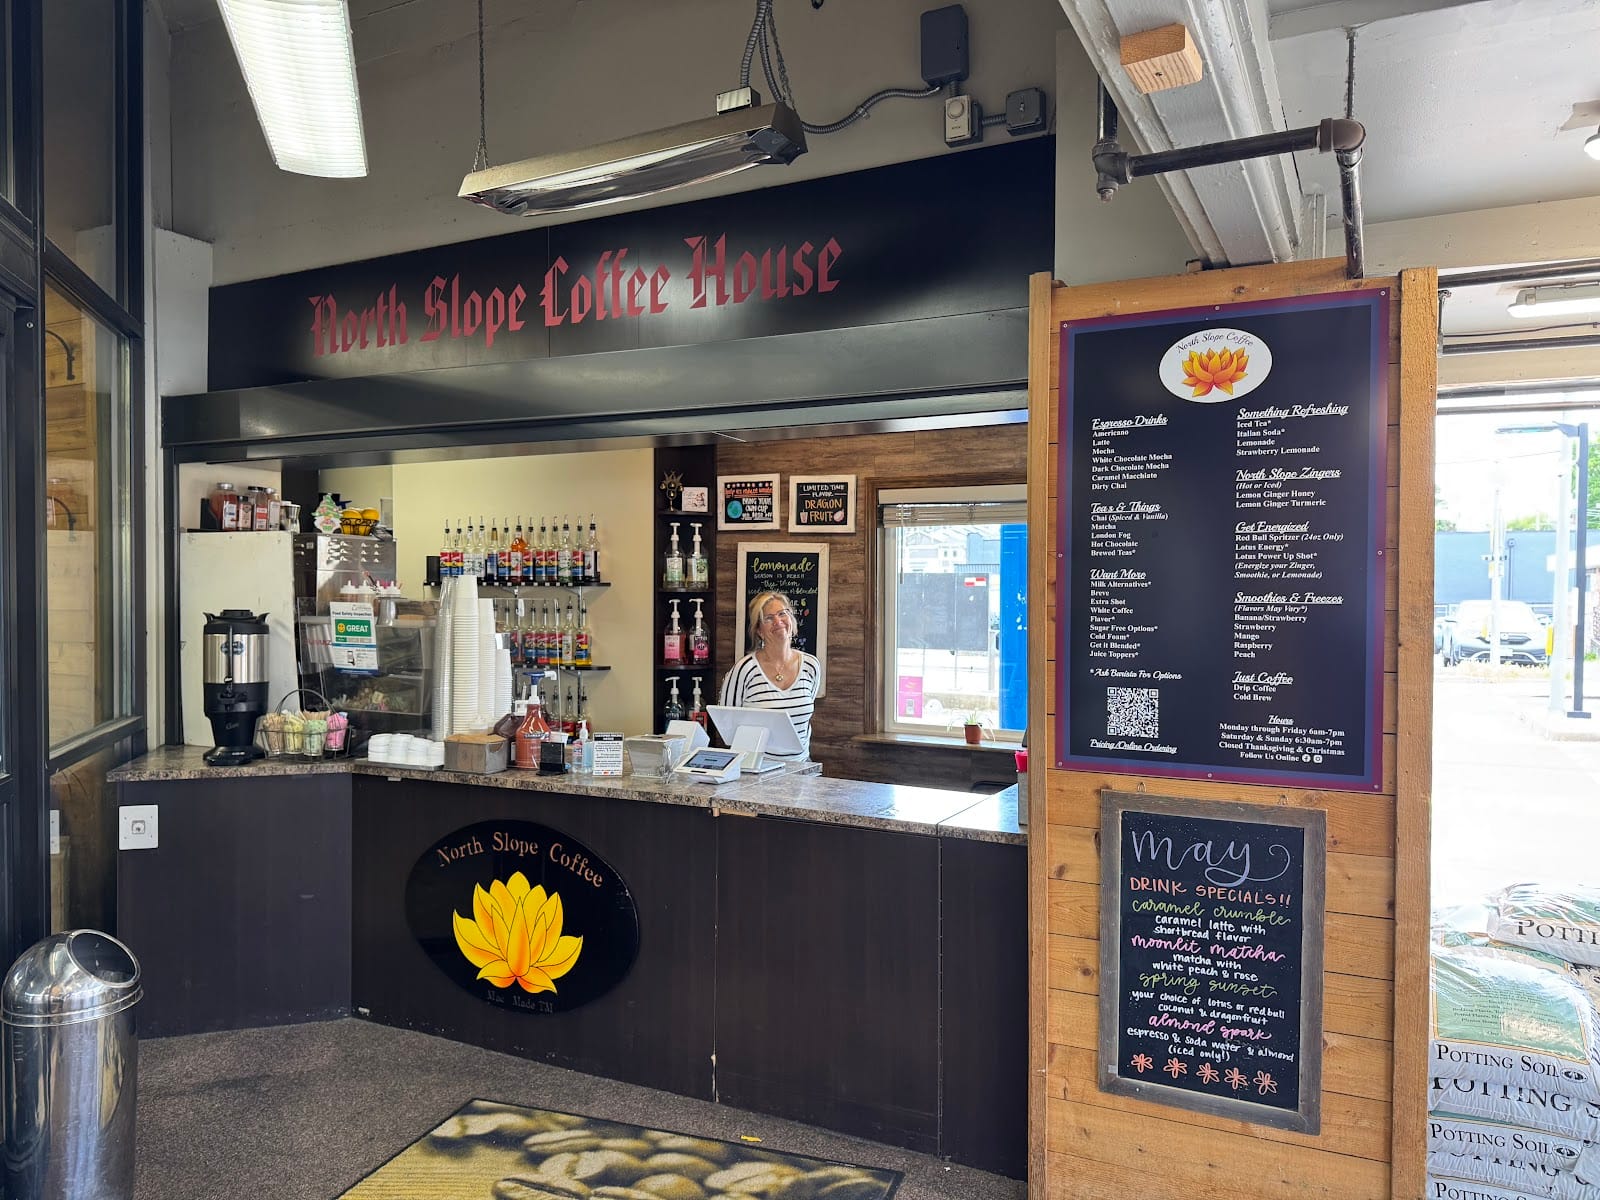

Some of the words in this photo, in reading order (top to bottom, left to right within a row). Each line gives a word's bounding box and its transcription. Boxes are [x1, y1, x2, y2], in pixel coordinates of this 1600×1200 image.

[308, 283, 408, 359] North
[419, 271, 528, 348] Slope
[539, 247, 671, 327] Coffee
[683, 232, 843, 309] House
[1175, 335, 1199, 354] North
[1201, 332, 1224, 343] Slope
[1226, 332, 1254, 347] Coffee
[1237, 407, 1290, 420] Something
[1291, 404, 1349, 417] Refreshing
[1092, 418, 1135, 430] Espresso
[1134, 414, 1168, 427] Drinks
[1092, 429, 1129, 437] Americano
[1236, 469, 1268, 481] North
[1270, 468, 1299, 481] Slope
[1301, 467, 1341, 480] Zingers
[1263, 491, 1289, 499] Ginger
[1292, 490, 1315, 498] Honey
[804, 498, 843, 509] DRAGON
[809, 511, 833, 522] FRUIT
[1235, 522, 1255, 533] Get
[1256, 521, 1309, 533] Energized
[1269, 533, 1300, 542] Spritzer
[1323, 533, 1343, 541] Only)
[751, 557, 815, 573] lemonade
[1090, 569, 1122, 579] Want
[1123, 569, 1146, 579] More
[1234, 592, 1288, 603] Smoothies
[1290, 593, 1303, 604] &
[1304, 593, 1344, 604] Freezes
[1235, 614, 1307, 622] Banana/Strawberry
[1234, 623, 1276, 631] Strawberry
[1234, 642, 1272, 650] Raspberry
[1232, 671, 1256, 685] Just
[1258, 672, 1293, 686] Coffee
[1234, 684, 1250, 692] Drip
[1220, 723, 1249, 732] Monday
[1251, 725, 1280, 734] through
[1283, 727, 1307, 735] Friday
[1309, 728, 1344, 737] 6am-7pm
[1221, 733, 1254, 742] Saturday
[1265, 735, 1293, 744] Sunday
[1295, 736, 1342, 747] 6:30am-7pm
[1245, 743, 1297, 754] Thanksgiving
[1306, 746, 1344, 756] Christmas
[436, 836, 485, 867] North
[492, 831, 539, 857] Slope
[549, 842, 603, 887] Coffee
[1129, 877, 1187, 896] DRINK
[1195, 885, 1291, 909] SPECIALS!!
[1132, 899, 1206, 916] caramel
[1213, 905, 1291, 926] crumble
[1155, 915, 1202, 928] caramel
[1209, 919, 1235, 932] latte
[1241, 924, 1266, 936] with
[1153, 925, 1210, 940] shortbread
[1215, 932, 1252, 943] flavor
[1131, 934, 1201, 954] moonlit
[1210, 944, 1286, 962] matcha
[1173, 954, 1211, 966] matcha
[1216, 959, 1241, 970] with
[1152, 961, 1184, 971] white
[1188, 965, 1218, 976] peach
[1234, 971, 1258, 982] rose
[1139, 972, 1201, 995] spring
[1208, 978, 1278, 997] sunset
[1131, 990, 1155, 1001] your
[1160, 992, 1187, 1004] choice
[1208, 998, 1233, 1009] lotus
[1236, 1003, 1244, 1011] or
[1158, 1003, 1194, 1015] coconut
[1200, 1009, 1207, 1017] &
[1209, 1010, 1269, 1025] dragonfruit
[1148, 1013, 1216, 1035] almond
[1219, 1025, 1272, 1041] spark
[1127, 1027, 1169, 1041] espresso
[1172, 1033, 1181, 1043] &
[1185, 1036, 1207, 1047] soda
[1212, 1041, 1241, 1053] water
[1247, 1047, 1254, 1056] &
[1258, 1049, 1295, 1062] almond
[1168, 1044, 1194, 1057] (iced
[1200, 1048, 1231, 1063] only!)
[1436, 1043, 1514, 1069] POTTING
[1429, 1123, 1506, 1148] POTTING
[1513, 1134, 1553, 1155] SOIL
[1435, 1182, 1509, 1200] POTTIN
